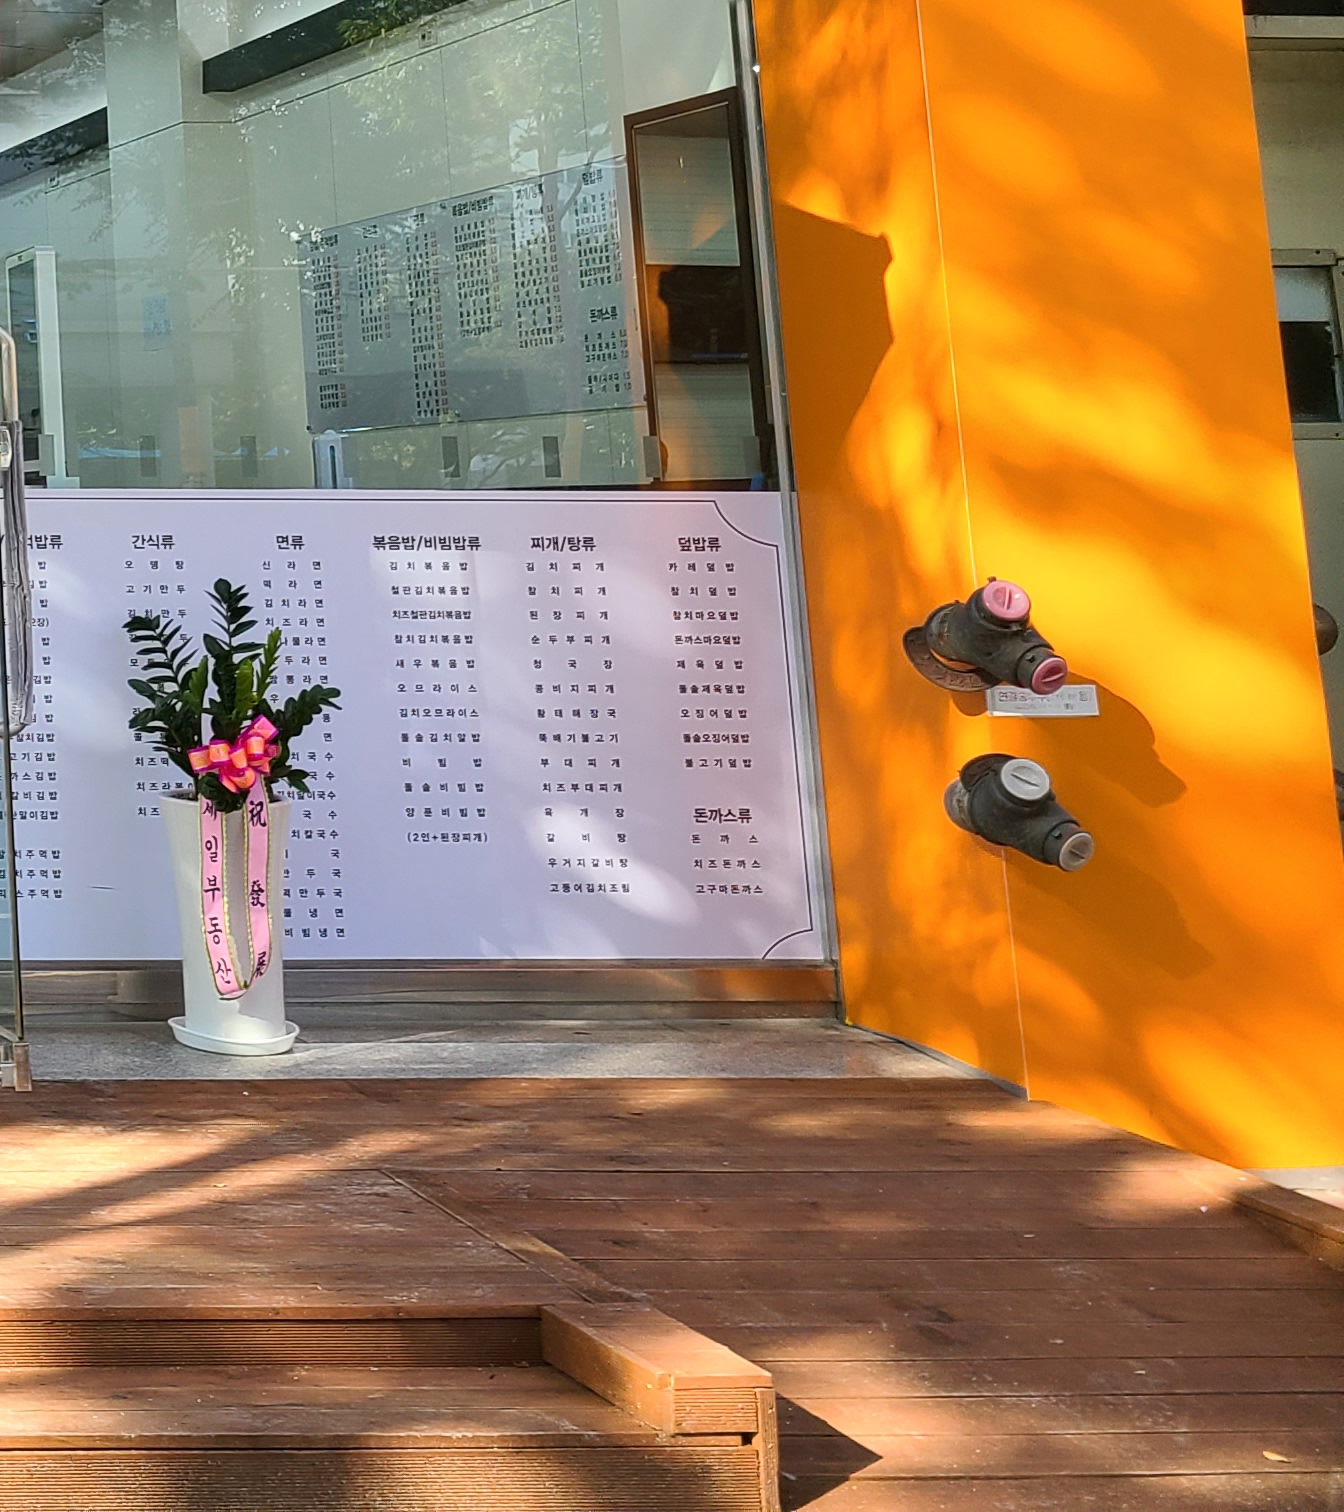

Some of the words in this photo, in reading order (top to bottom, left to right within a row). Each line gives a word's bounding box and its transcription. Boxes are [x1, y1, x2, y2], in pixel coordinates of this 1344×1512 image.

[131, 534, 175, 550] 간식류
[276, 535, 305, 550] 면류
[372, 535, 482, 551] 볶음밥/비빔밥류
[530, 536, 597, 552] 찌개/탕류
[678, 536, 722, 552] 덮밥류
[124, 560, 184, 570] 오뎅탕
[262, 561, 321, 571] 신라면
[389, 561, 468, 571] 김치볶음밥
[525, 562, 604, 572] 김치찌개
[668, 562, 735, 572] 카레덮밥
[126, 584, 186, 594] 고기만두
[263, 579, 322, 590] 떡라면
[528, 586, 606, 596] 참치찌개
[671, 586, 737, 597] 참치덮밥
[264, 598, 324, 608] 김치라면
[529, 610, 608, 621] 된장찌개
[673, 610, 739, 621] 참치마요덮밥
[265, 617, 325, 630] 치즈라면
[281, 637, 326, 646] 나물라면
[394, 634, 474, 645] 참치김치볶음밥
[531, 635, 611, 645] 순두부찌개
[674, 635, 741, 645] 돈까스마요덮밥
[284, 656, 327, 665] 두라면
[395, 659, 475, 669] 새우볶음밥
[533, 659, 613, 670] 청국장
[676, 659, 743, 670] 제육덮밥
[397, 683, 478, 693] 오므라이스
[535, 684, 615, 694] 콩비지찌개
[399, 708, 479, 718] 김치오므라이스
[537, 708, 616, 719] 황태해장국
[680, 708, 748, 719] 오징어덮밥
[291, 752, 333, 761] 치국수
[402, 758, 483, 768] 비빔밥
[540, 758, 621, 768] 부대찌개
[685, 758, 752, 768] 불고기덮밥
[542, 783, 622, 793] 치즈부대찌개
[544, 807, 625, 818] 육개장
[693, 808, 753, 824] 돈까스류
[291, 830, 339, 839] 치칼국수
[546, 833, 627, 843] 갈비탕
[691, 834, 759, 844] 돈까스
[547, 857, 628, 869] 우거지갈비탕
[693, 859, 761, 869] 치즈돈까스
[549, 883, 630, 894] 고등어김치조림
[695, 884, 763, 895] 고구마돈까스
[285, 928, 345, 938] 비빔냉면
